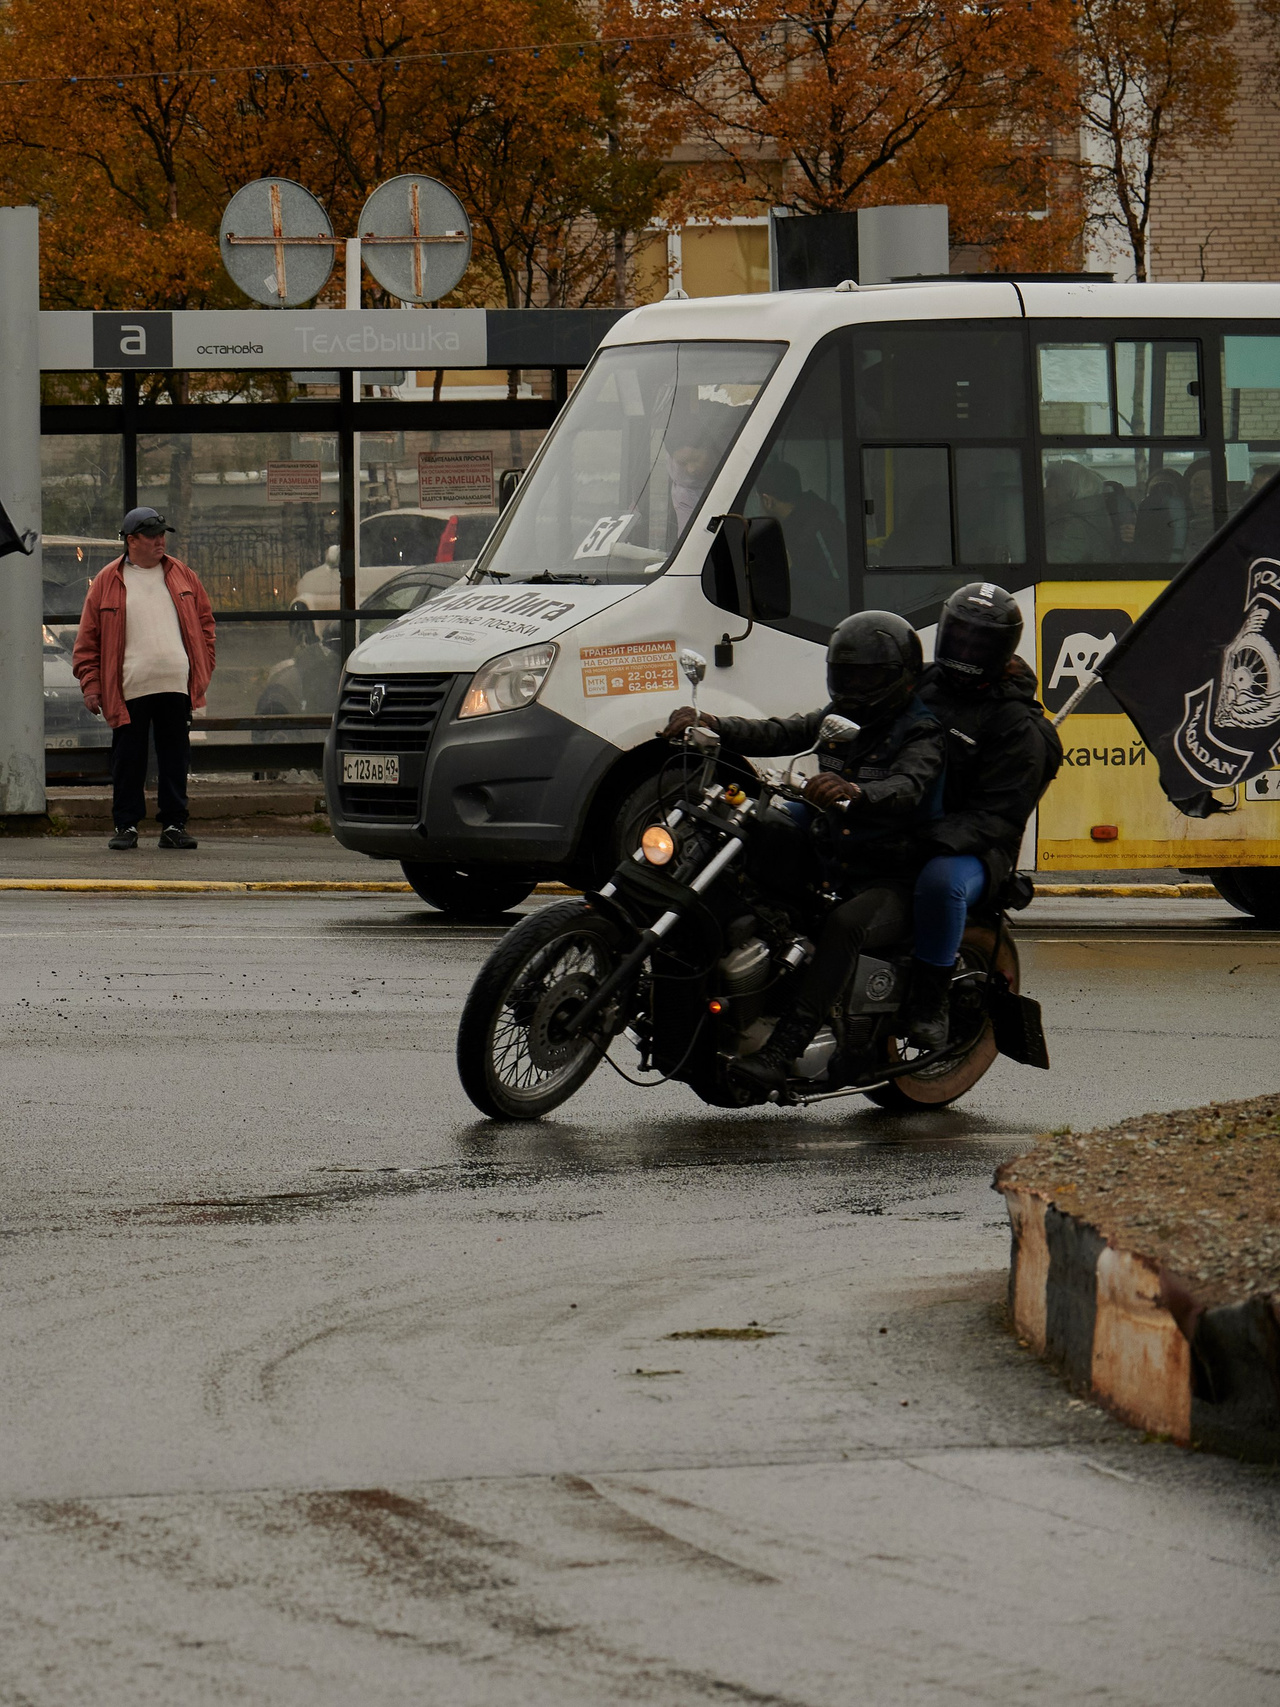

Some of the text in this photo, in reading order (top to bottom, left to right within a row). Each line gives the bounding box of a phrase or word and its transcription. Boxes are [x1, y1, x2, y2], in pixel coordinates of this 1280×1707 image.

[196, 342, 264, 355] остановка
[422, 474, 491, 485] НЕ РАЗМЕЩАТЬ
[582, 518, 624, 553] 57
[480, 617, 541, 636] поездки
[583, 643, 673, 658] ТРАНЗИТ РЕКЛАМА
[583, 653, 674, 667] НА БОРТАХ АВТОБУСА
[628, 669, 675, 681] 22-01-22
[587, 678, 606, 686] МТК
[628, 680, 675, 692] 62-64-52
[385, 759, 396, 775] 49
[1042, 851, 1055, 861] 0+
